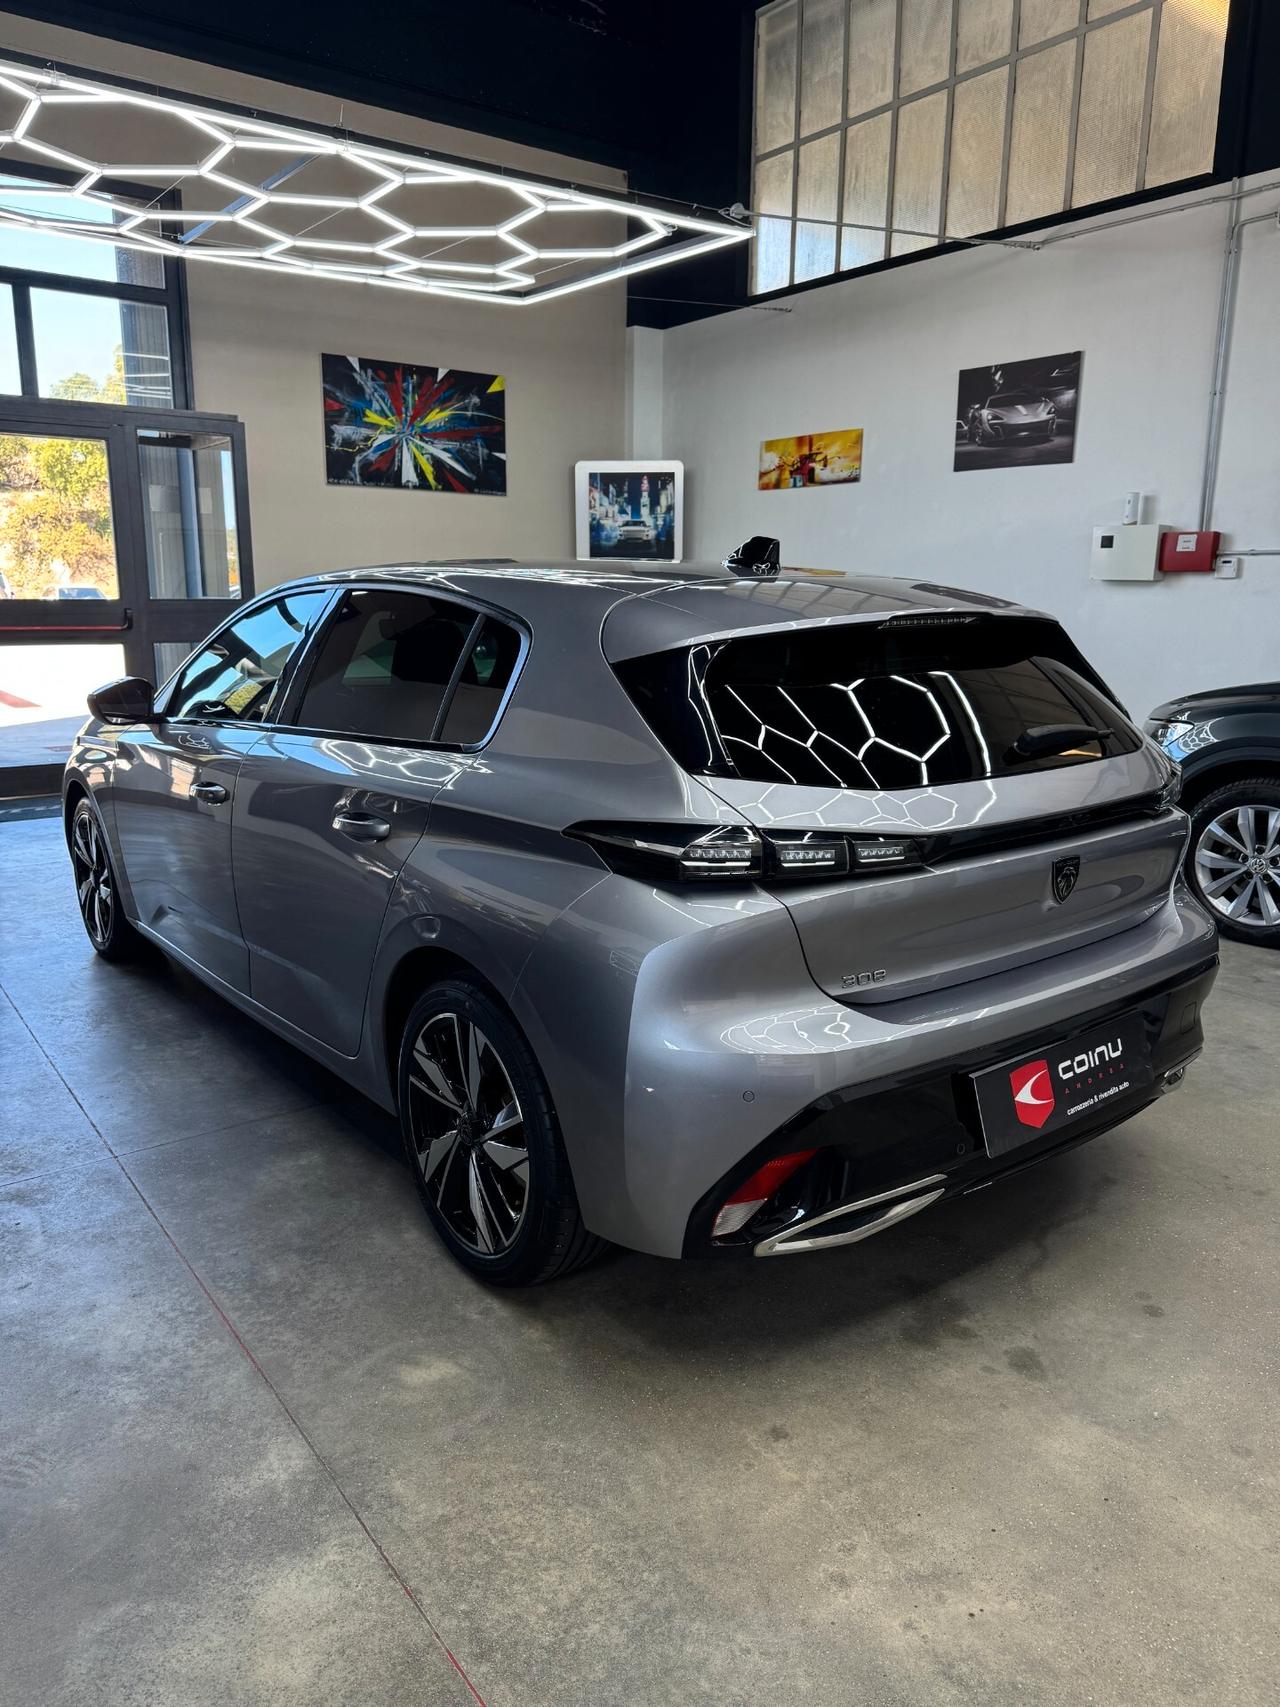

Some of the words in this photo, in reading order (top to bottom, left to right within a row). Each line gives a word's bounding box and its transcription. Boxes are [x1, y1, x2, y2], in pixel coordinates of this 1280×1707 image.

[1067, 1098, 1094, 1115] carrozzeria
[1098, 1086, 1119, 1101] rivendita
[1119, 1081, 1130, 1091] auto
